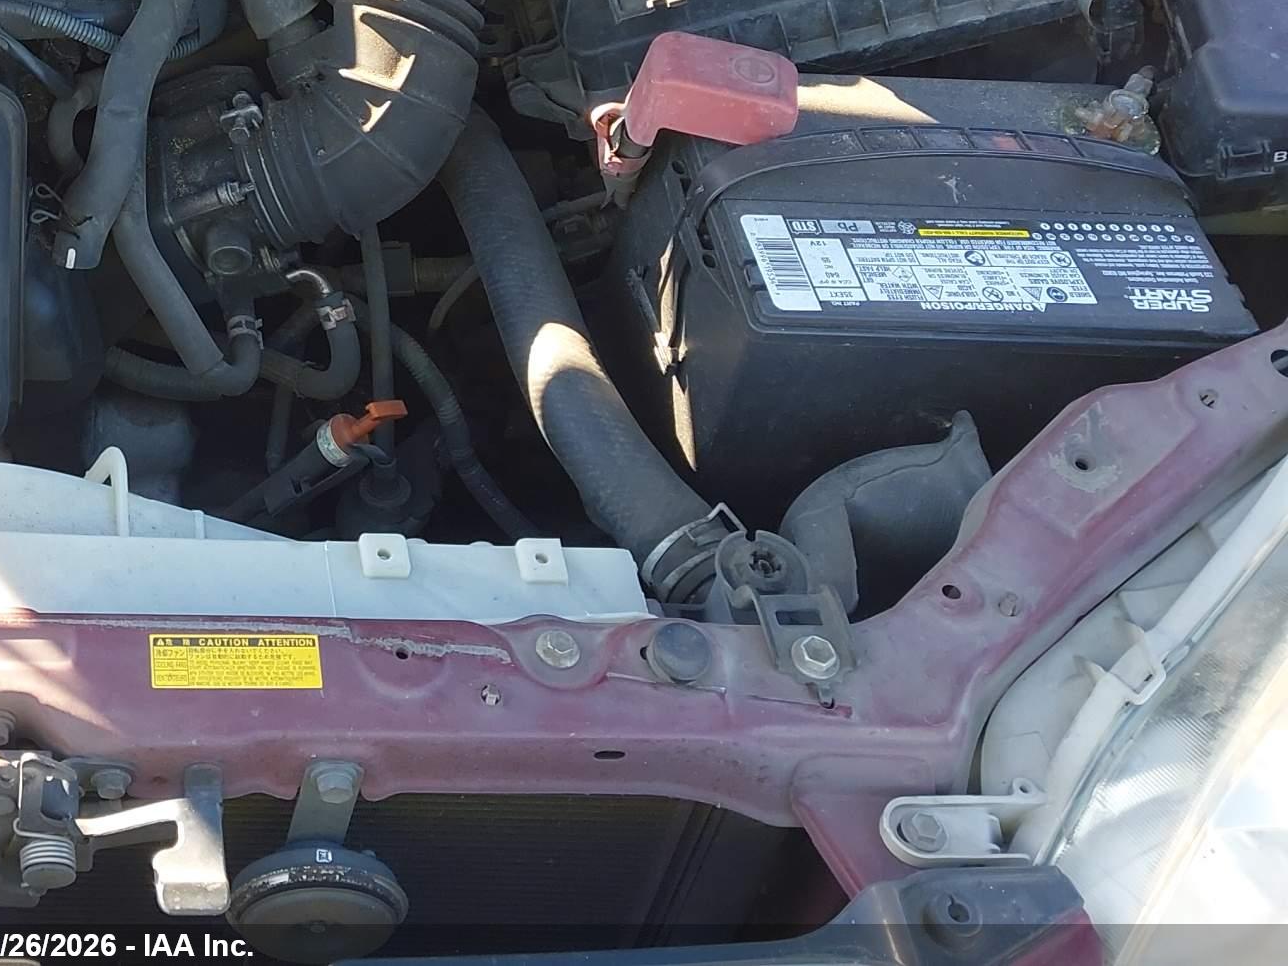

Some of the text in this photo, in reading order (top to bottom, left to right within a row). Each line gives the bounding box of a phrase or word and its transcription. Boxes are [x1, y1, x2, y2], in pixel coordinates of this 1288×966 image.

[837, 222, 858, 232] Pb
[1129, 288, 1212, 302] START
[920, 301, 1034, 311] DANGER/POISON
[1132, 299, 1210, 312] SUPER
[199, 638, 314, 647] CAUTION ATTENTION
